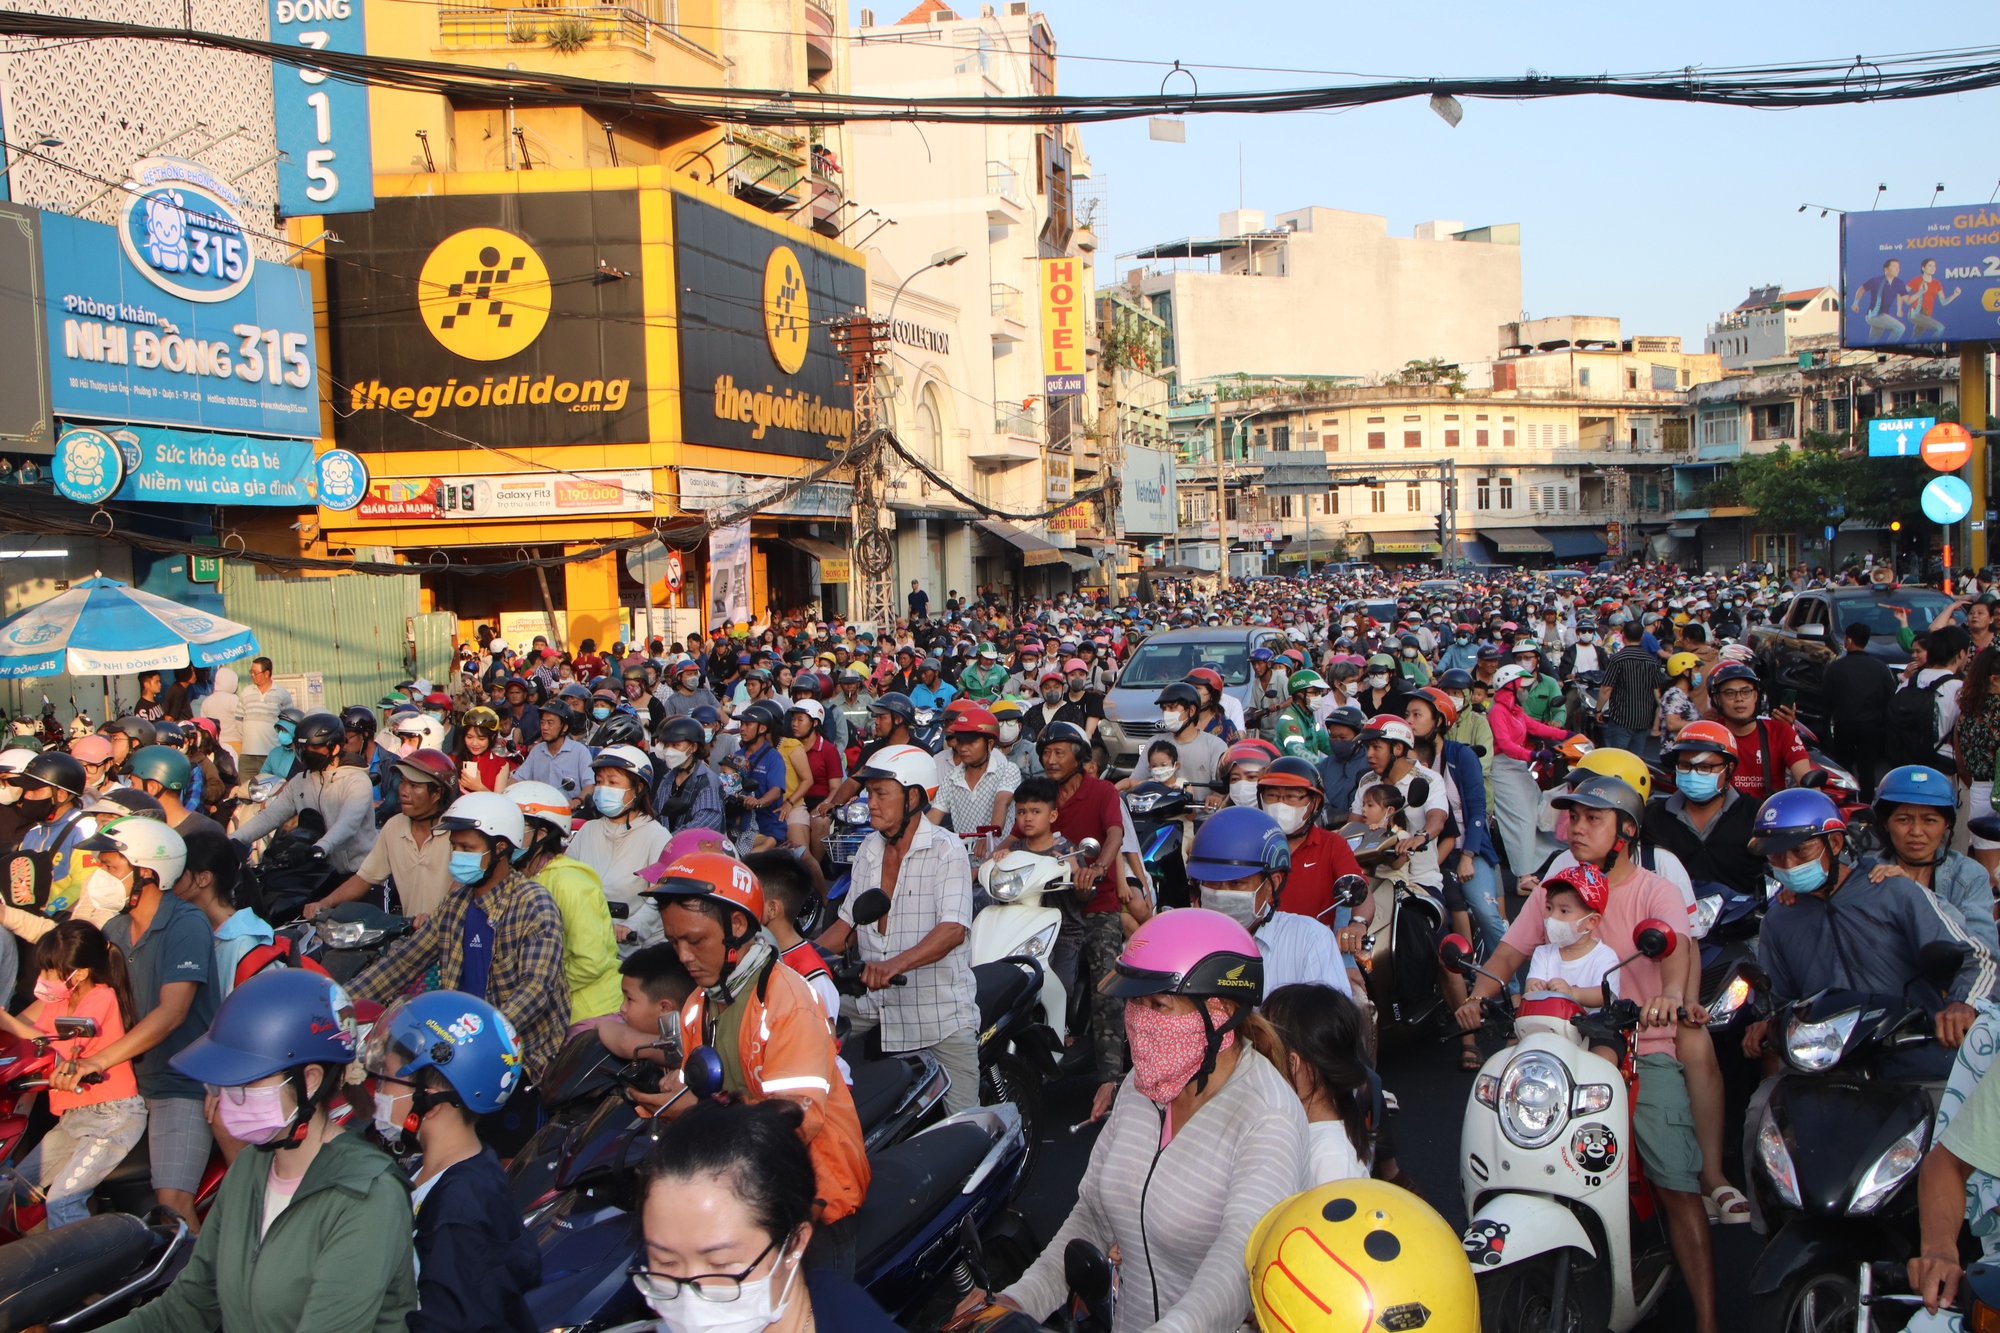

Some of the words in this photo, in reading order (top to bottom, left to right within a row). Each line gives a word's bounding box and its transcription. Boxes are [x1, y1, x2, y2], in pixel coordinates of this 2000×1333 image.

[1906, 235, 1962, 250] XƯƠNG
[189, 229, 243, 282] 315
[1945, 266, 1982, 279] MUA
[64, 294, 116, 321] Phòng
[119, 301, 158, 325] khám
[1050, 262, 1073, 371] HOTEL
[893, 319, 949, 356] COLLECTION
[65, 319, 129, 365] NHI
[133, 317, 232, 378] ĐỒNG
[233, 323, 311, 389] 315
[1047, 377, 1063, 392] QUẾ
[1064, 380, 1081, 390] ANH
[351, 375, 630, 418] thegioididong
[568, 403, 600, 412] .com
[714, 374, 853, 449] thegioididong
[1878, 420, 1914, 432] QUẬN
[1919, 421, 1926, 429] 1
[155, 443, 186, 464] Sức
[189, 446, 226, 467] khỏe
[231, 449, 259, 469] của
[262, 451, 280, 470] bé
[139, 469, 182, 491] Niềm
[185, 476, 208, 493] vui
[211, 473, 240, 494] của
[244, 477, 266, 497] gia
[269, 478, 297, 496] đình
[60, 482, 71, 494] NHI
[71, 489, 92, 500] ĐỒNG
[92, 485, 107, 498] 315
[496, 490, 531, 501] Galaxy
[534, 489, 551, 499] Fit3
[558, 488, 619, 501] 1.190.000
[346, 494, 357, 505] 315
[405, 504, 434, 515] MẠNH
[1049, 519, 1066, 530] CHO
[200, 559, 215, 572] 315
[223, 648, 245, 659] ĐỒNG
[103, 662, 123, 670] NHI
[126, 657, 160, 669] ĐỒNG
[162, 655, 179, 664] 315
[13, 664, 39, 675] ĐỒNG
[581, 670, 590, 684] 2
[1292, 679, 1306, 688] Grab
[1217, 979, 1249, 987] HONDA
[1584, 1175, 1601, 1186] 10
